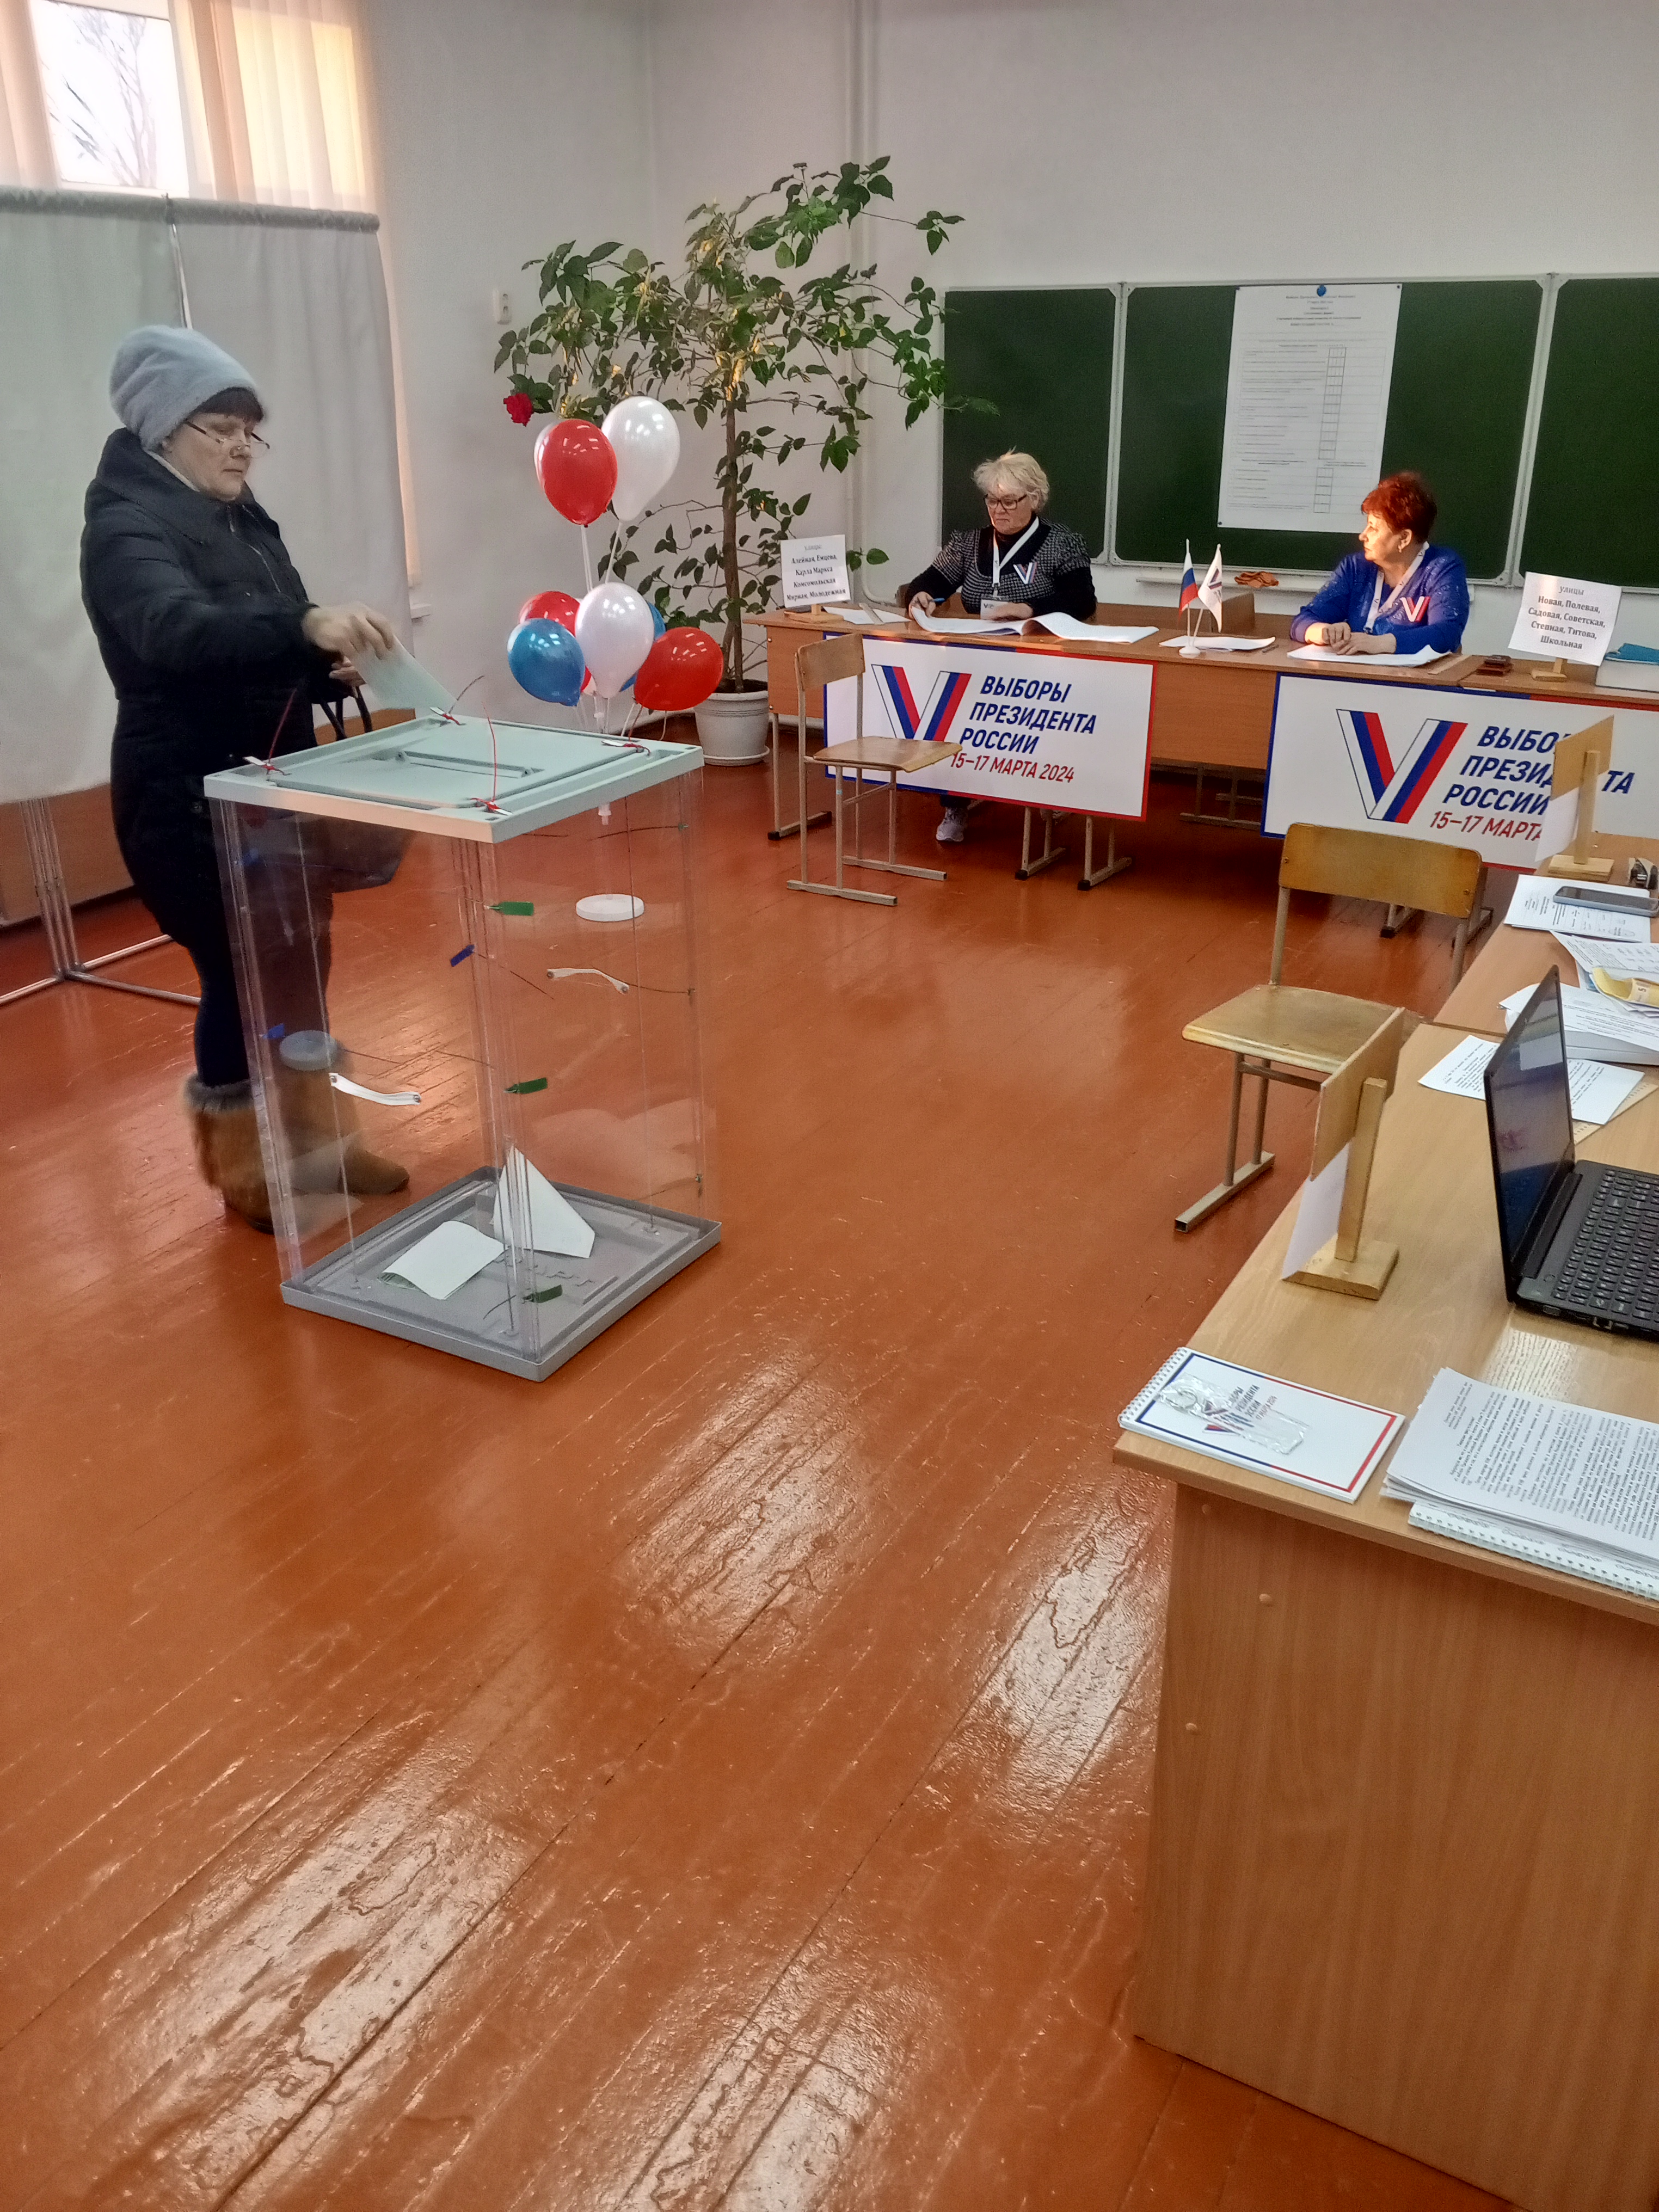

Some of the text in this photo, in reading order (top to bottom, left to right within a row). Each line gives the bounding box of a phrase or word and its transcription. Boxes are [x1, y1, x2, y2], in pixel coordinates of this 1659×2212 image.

[794, 578, 835, 588] Комсомольская
[1558, 586, 1584, 595] улицы
[1538, 595, 1600, 613] Новая, Полевая,
[1528, 607, 1605, 628] Садовая, Советская,
[1531, 620, 1597, 640] Степная, Титова,
[1540, 635, 1582, 649] Школьная
[980, 675, 1072, 703] ВЫБОРЫ
[969, 702, 1097, 734] ПРЕЗИДЕНТА
[959, 728, 1040, 754] РОССИИ
[1477, 726, 1571, 754] ВЫБО
[990, 757, 1038, 778] МАРТА
[1039, 763, 1074, 783] 2024
[1442, 784, 1551, 815] РОССИИ
